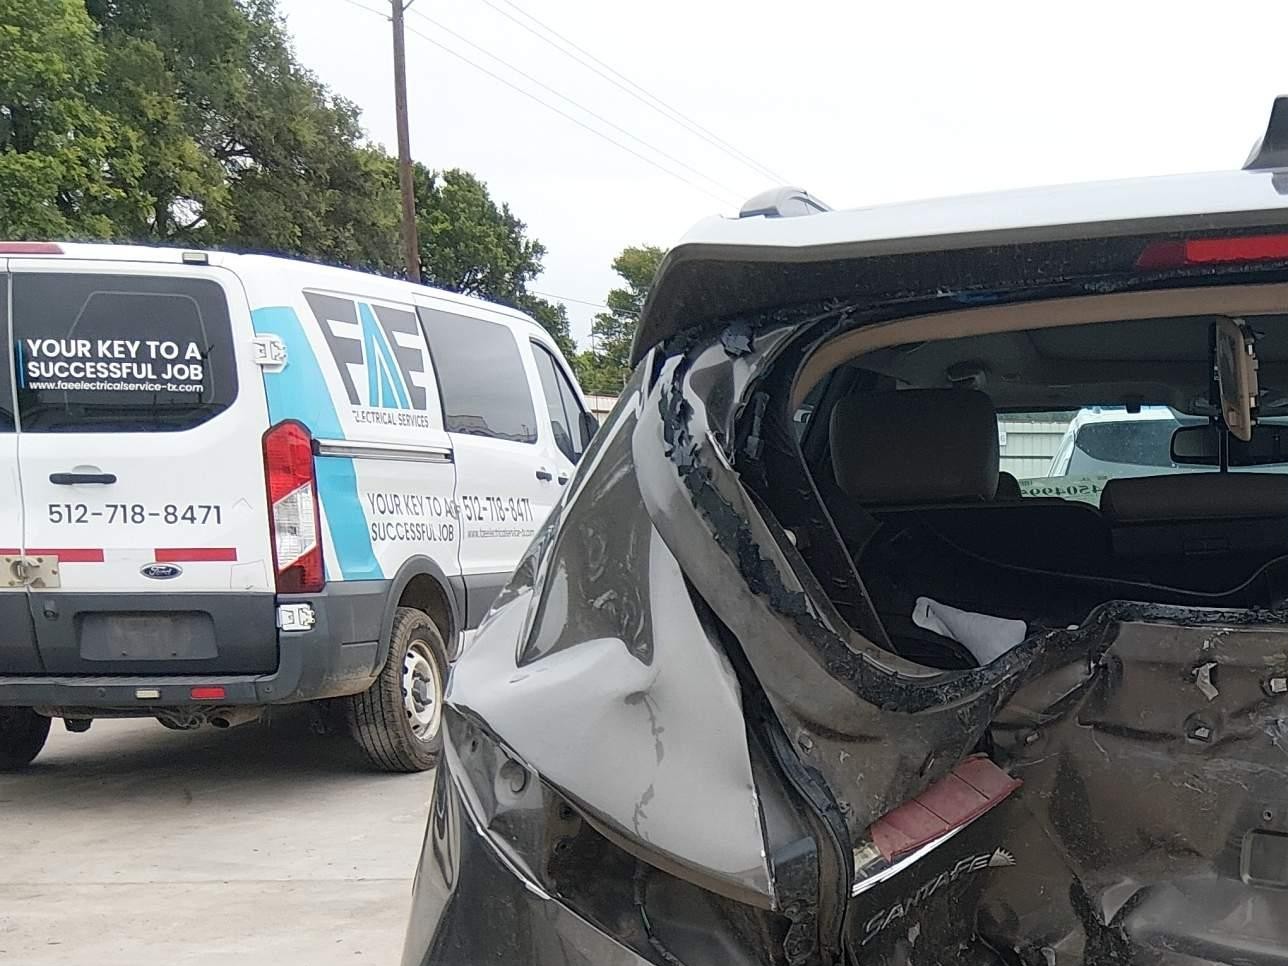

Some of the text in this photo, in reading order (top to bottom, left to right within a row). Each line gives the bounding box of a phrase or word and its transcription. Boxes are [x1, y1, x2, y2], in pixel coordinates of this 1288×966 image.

[27, 339, 202, 360] YOUR KEY TO A
[301, 291, 427, 411] FAE
[28, 362, 203, 381] SUCCESSFUL JOB
[29, 380, 204, 393] www.faeelectricalservice-tx.com
[398, 413, 429, 428] SERVICES
[48, 504, 222, 525] 512-718-8471
[367, 493, 404, 515] YOUR
[403, 494, 425, 516] KEY
[425, 497, 443, 517] TO
[462, 495, 534, 522] 512-718-8471
[371, 522, 436, 542] SUCCESSFUL
[437, 524, 455, 542] JOB
[149, 565, 172, 577] Ford
